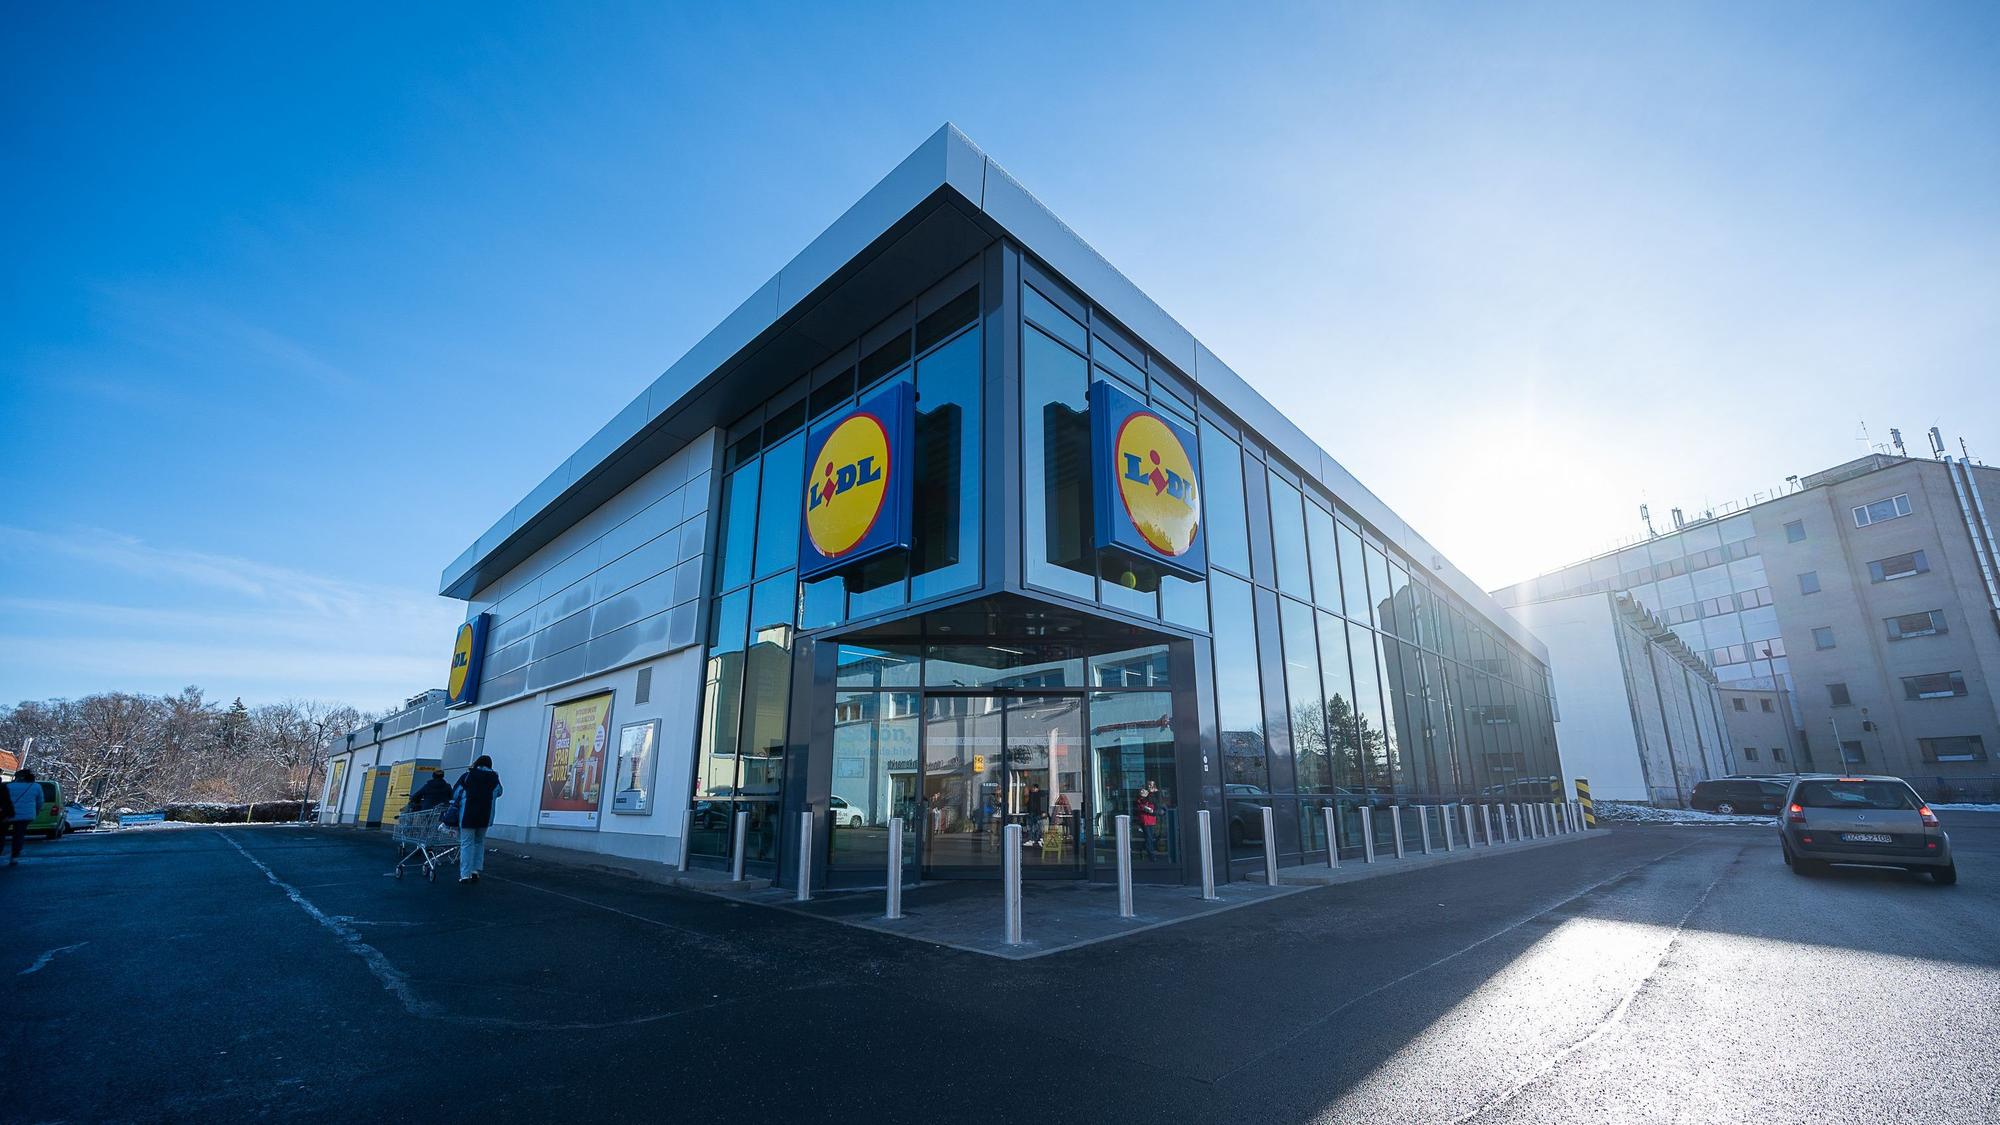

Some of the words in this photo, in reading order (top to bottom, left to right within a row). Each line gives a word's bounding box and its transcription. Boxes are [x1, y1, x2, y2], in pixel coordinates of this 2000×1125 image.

[808, 456, 881, 511] LIDL
[1123, 450, 1196, 506] LIDL
[453, 652, 468, 668] DL
